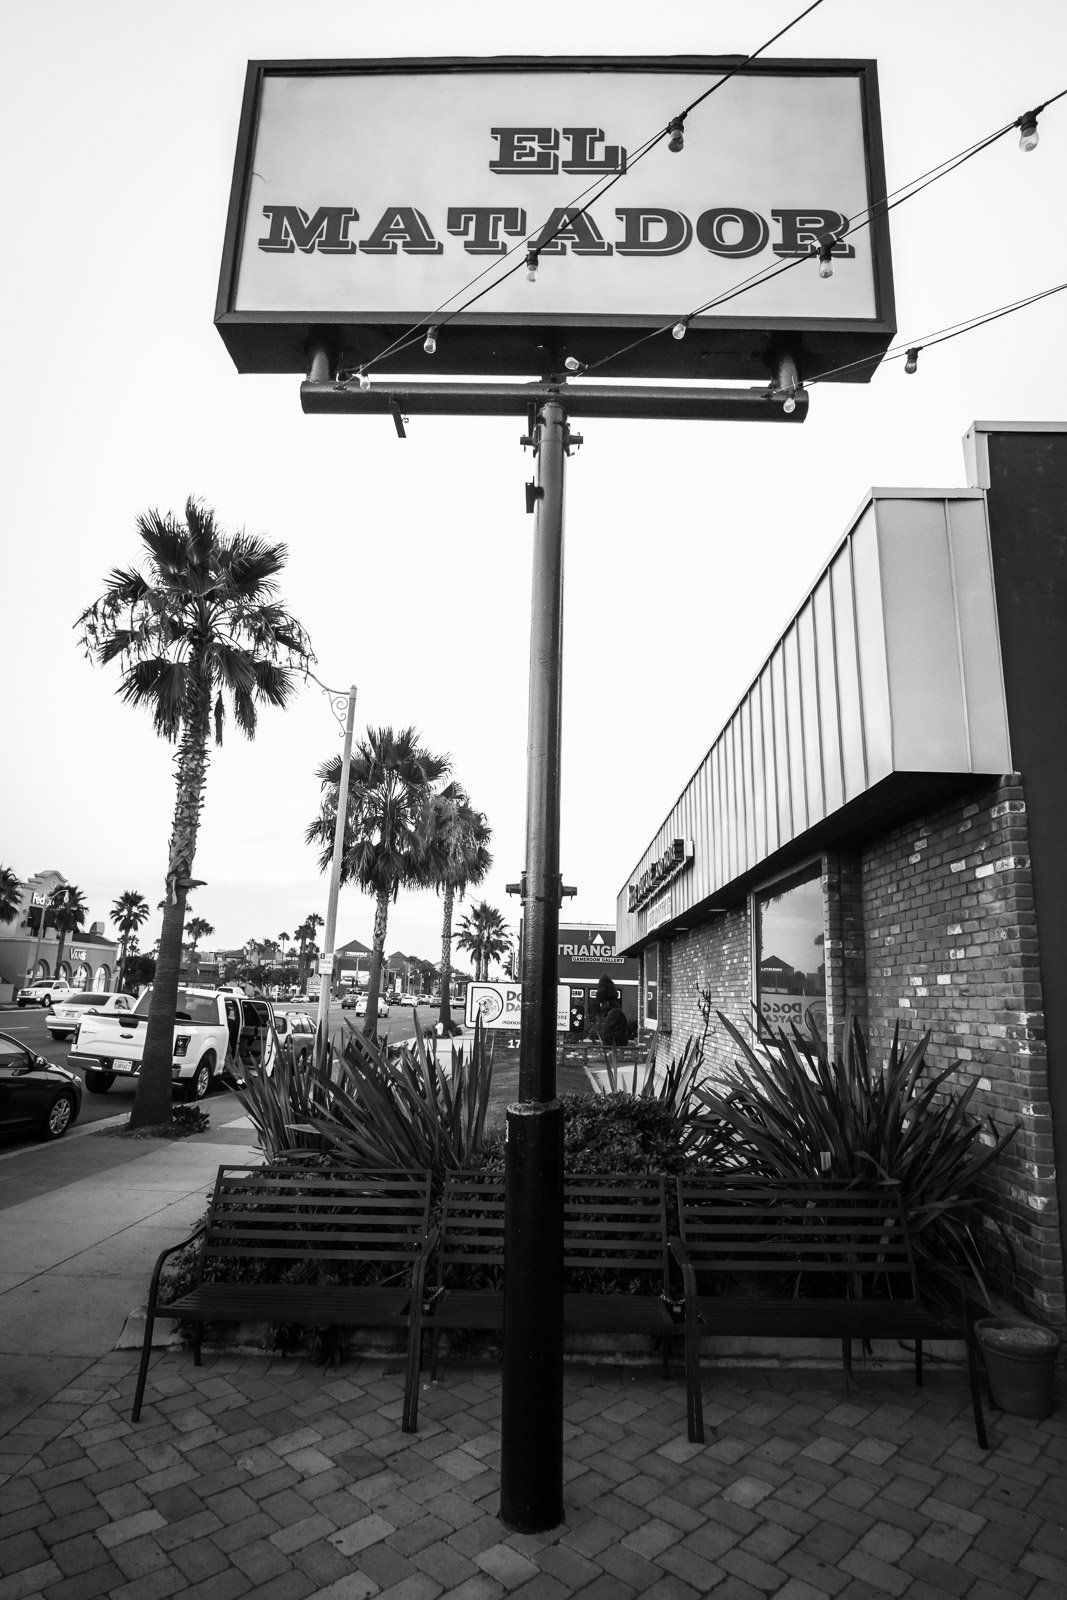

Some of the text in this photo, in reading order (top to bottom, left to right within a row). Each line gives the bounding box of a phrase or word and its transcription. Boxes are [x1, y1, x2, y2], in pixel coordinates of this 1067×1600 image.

[489, 126, 627, 175] EL
[257, 205, 856, 259] MATADOR
[70, 948, 87, 960] VANS
[558, 944, 628, 957] TRIANGL
